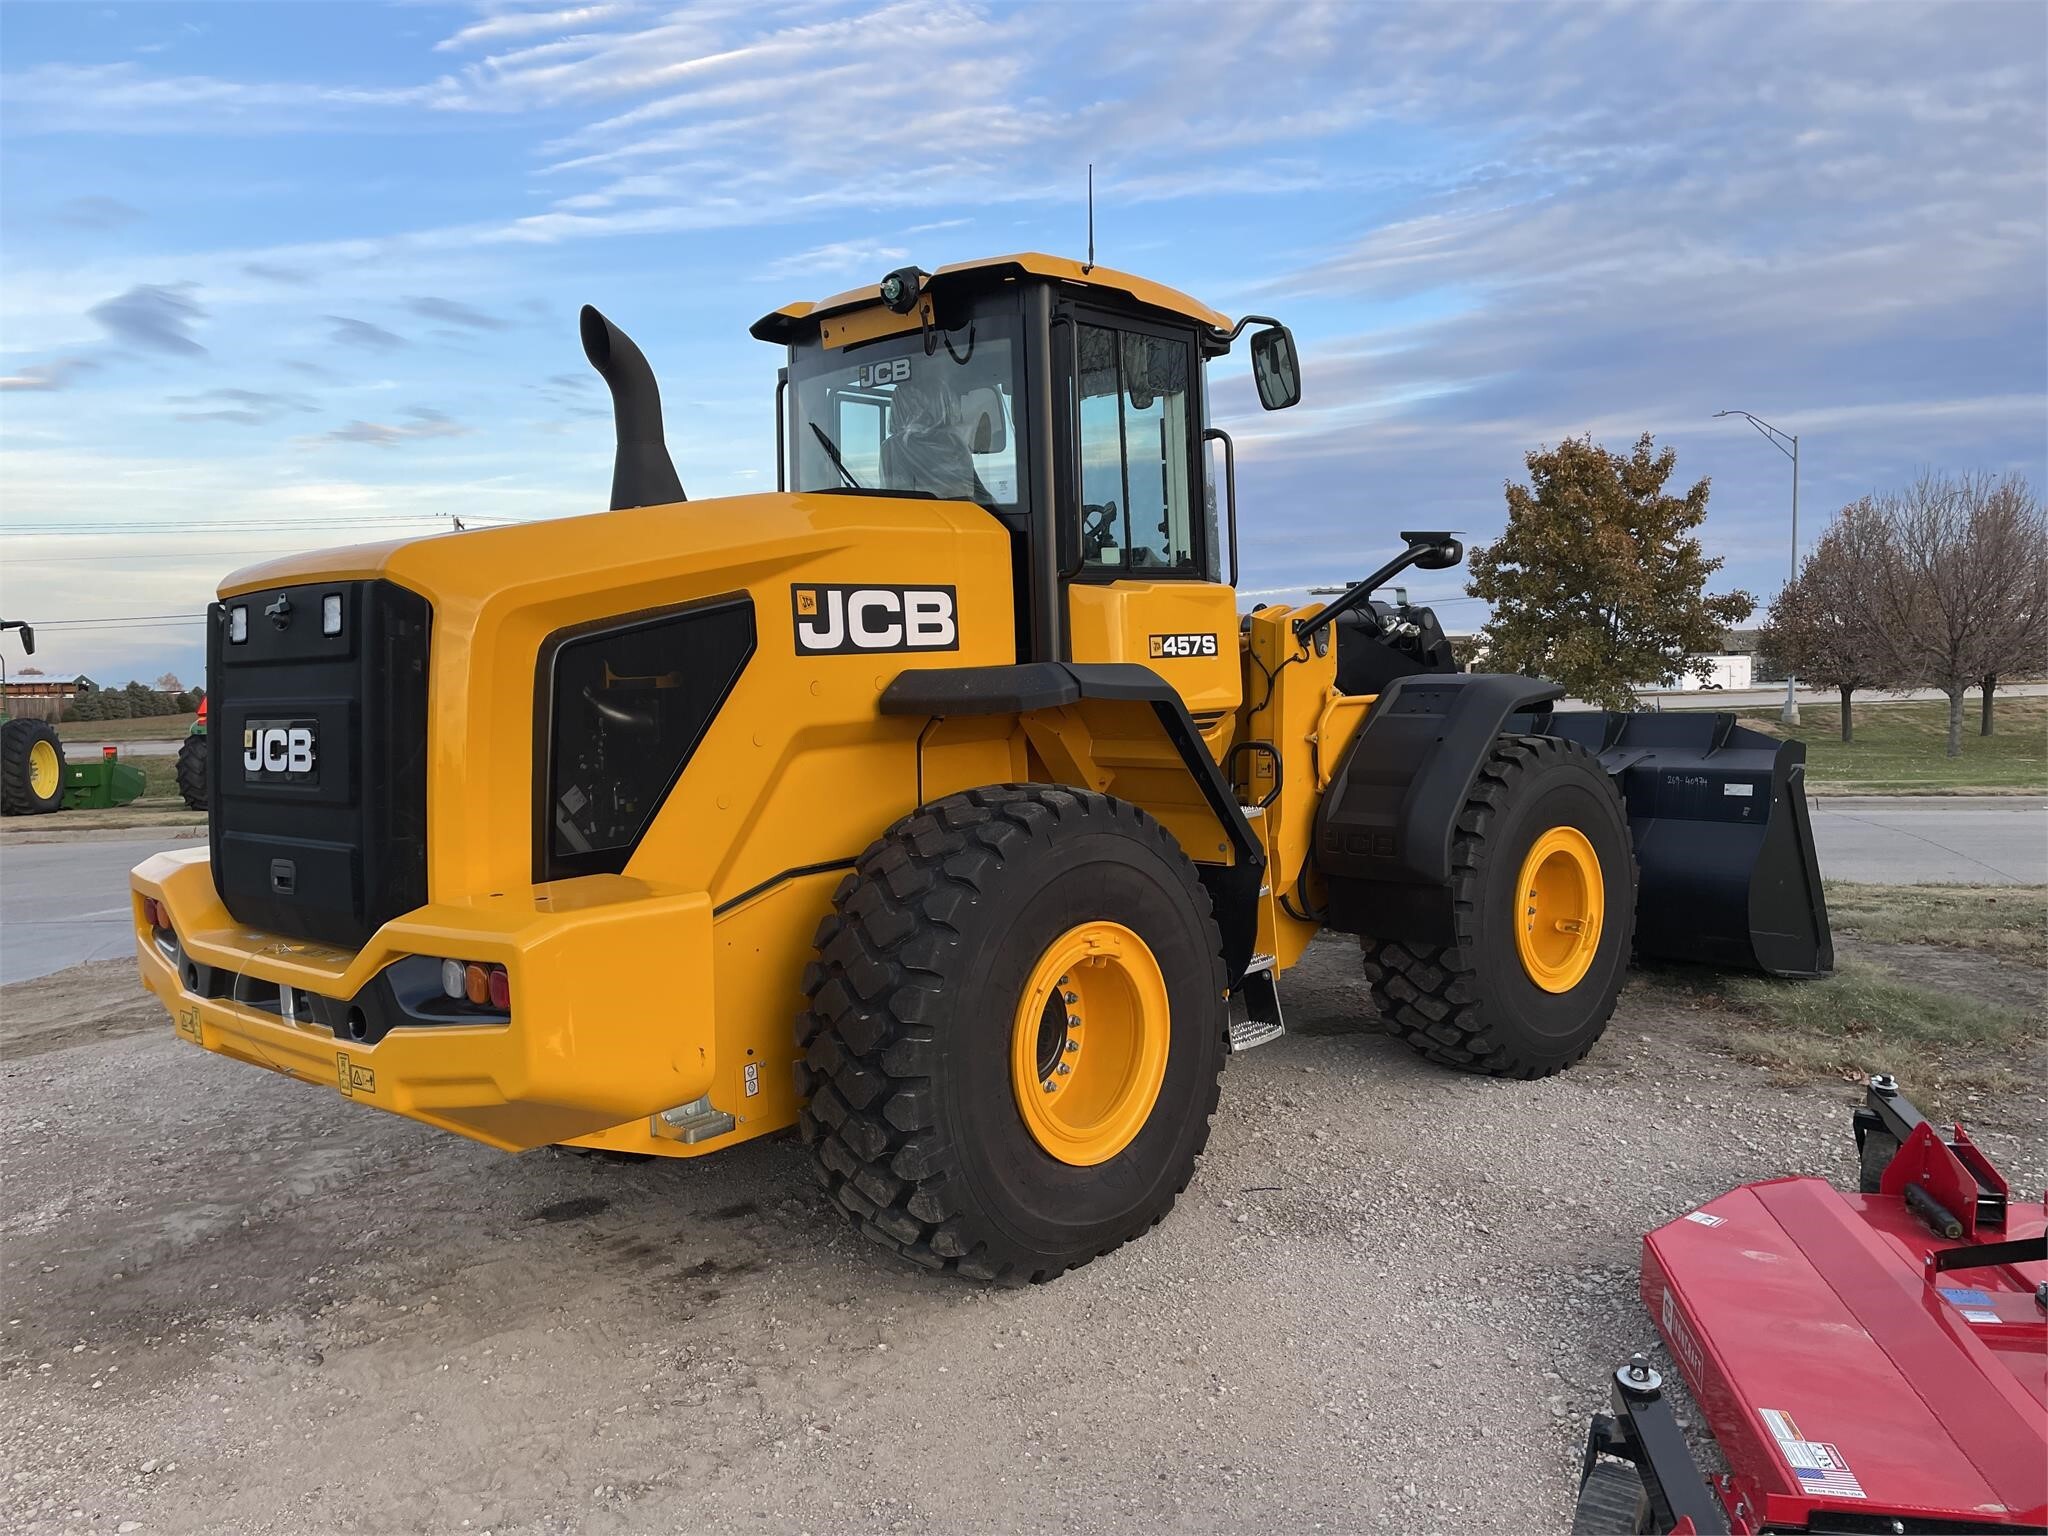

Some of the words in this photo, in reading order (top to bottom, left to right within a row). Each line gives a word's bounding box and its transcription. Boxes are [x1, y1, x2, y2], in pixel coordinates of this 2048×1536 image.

[860, 359, 911, 388] JCB
[798, 589, 955, 649] JCB
[1163, 635, 1216, 656] 457S
[244, 728, 313, 773] JCB
